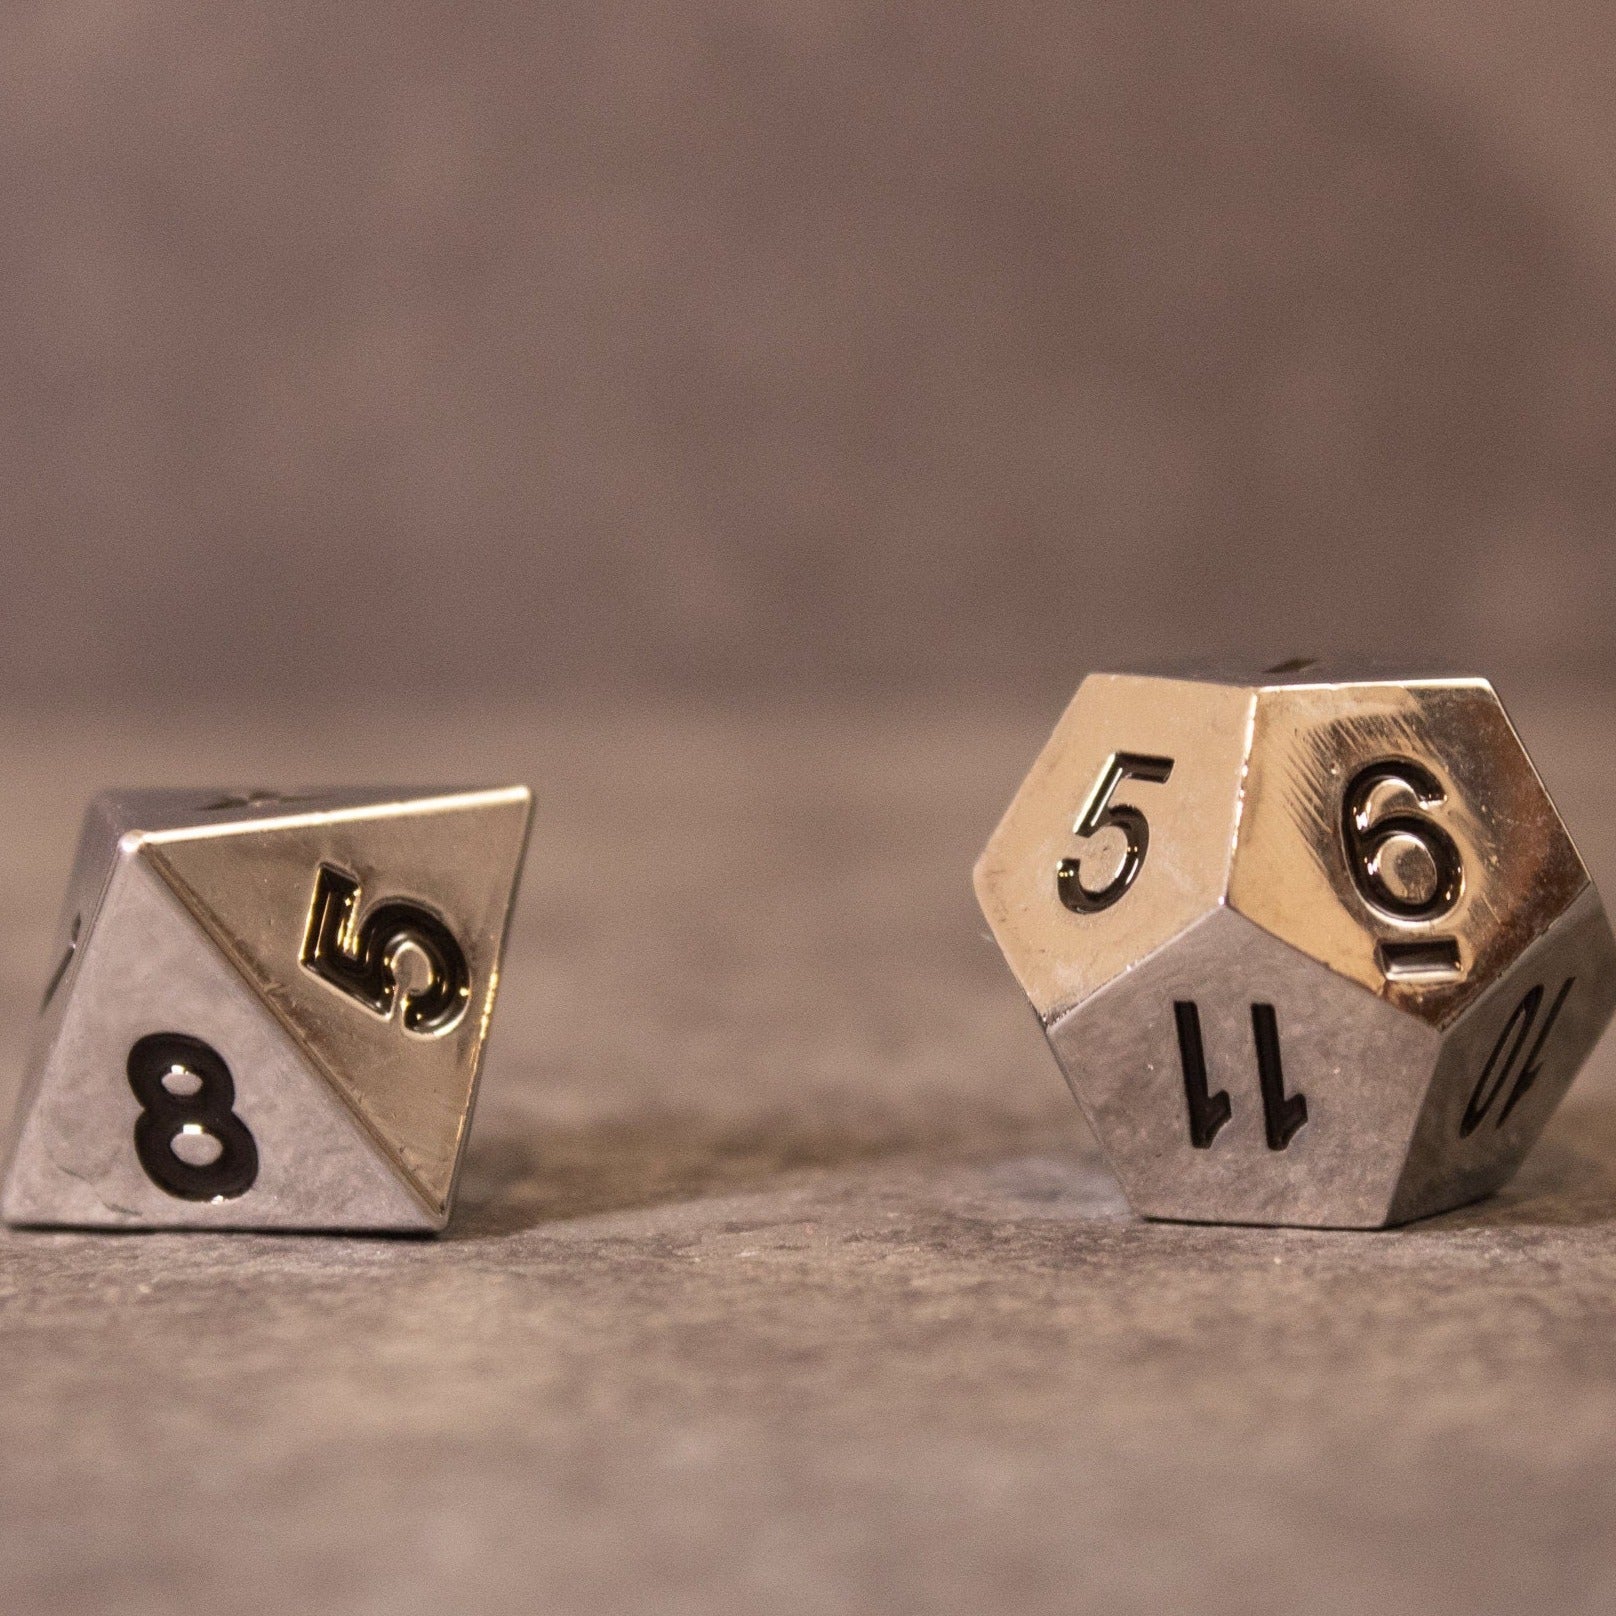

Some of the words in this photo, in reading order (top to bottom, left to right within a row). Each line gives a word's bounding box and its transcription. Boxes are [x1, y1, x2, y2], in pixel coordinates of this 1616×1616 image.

[1056, 751, 1175, 915] 5
[1340, 754, 1466, 926] 6
[299, 861, 472, 1039] 5
[126, 1032, 260, 1204] 8
[1173, 1000, 1309, 1153] 11
[1459, 976, 1577, 1139] 10
